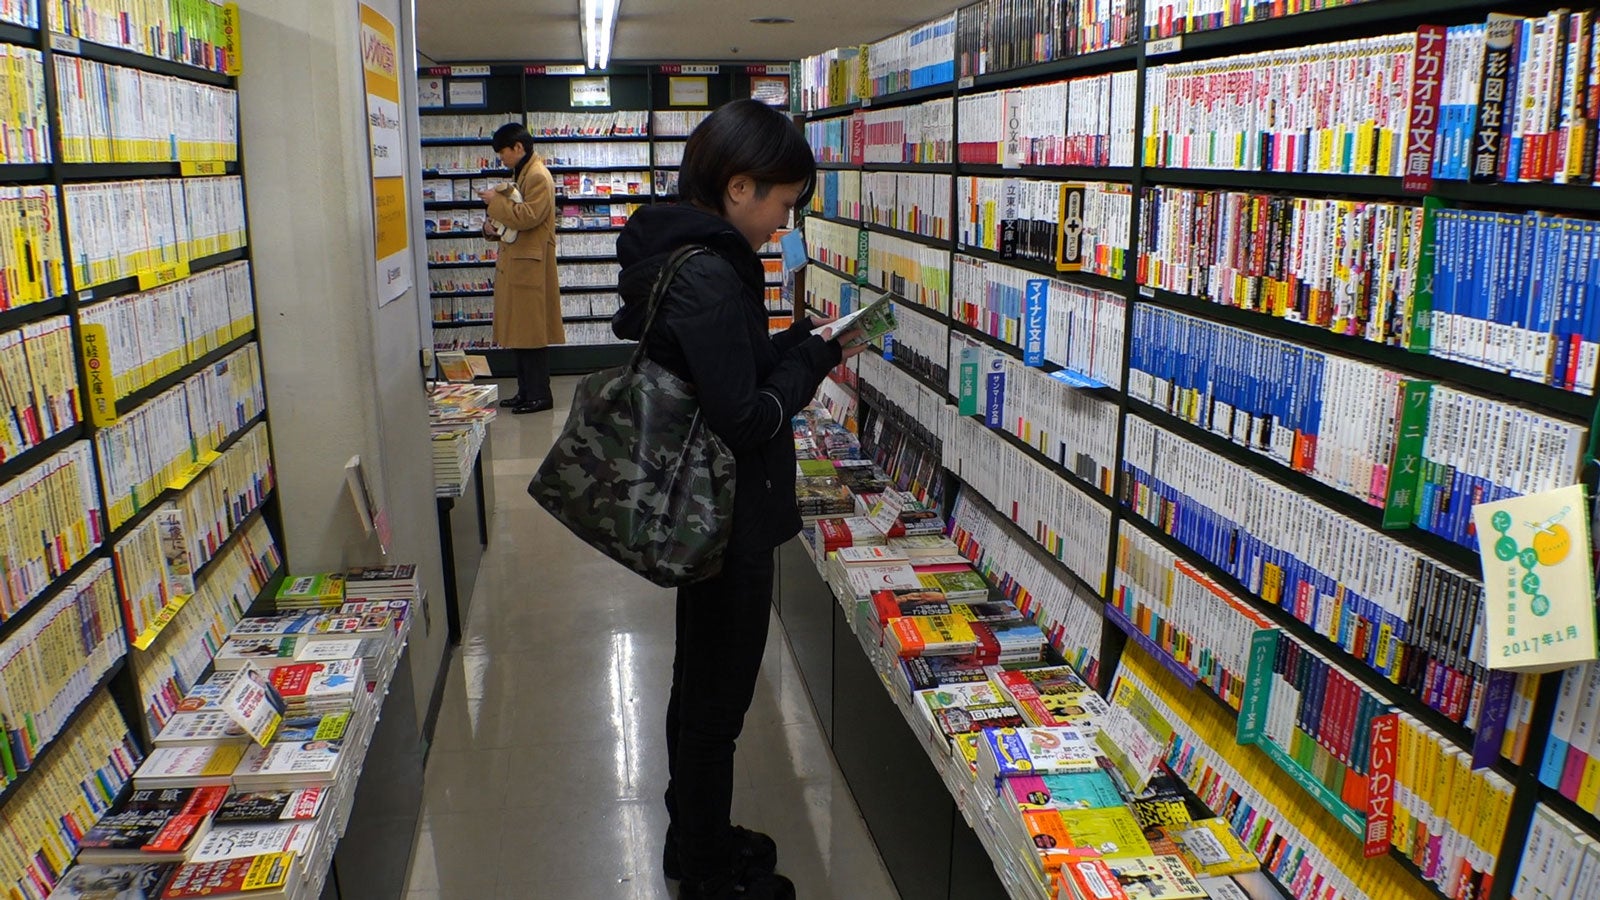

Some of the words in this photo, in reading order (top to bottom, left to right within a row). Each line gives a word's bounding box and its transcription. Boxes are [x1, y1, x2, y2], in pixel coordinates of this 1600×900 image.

[1008, 106, 1019, 154] TO文庫
[1405, 28, 1443, 176] ナガオカ文庫
[1474, 52, 1507, 177] 彩図社文庫
[1003, 184, 1016, 242] 立東舎文庫
[1066, 236, 1077, 259] PLUS
[1028, 281, 1042, 353] マイナビ文庫
[85, 334, 103, 395] 中経の文庫
[990, 375, 1001, 425] サンマーク文庫
[1391, 391, 1426, 509] ワニ文庫
[1502, 625, 1578, 658] 2017年1月
[1244, 645, 1266, 731] ハリー・ポッター文庫
[1366, 719, 1393, 843] だいわ文庫
